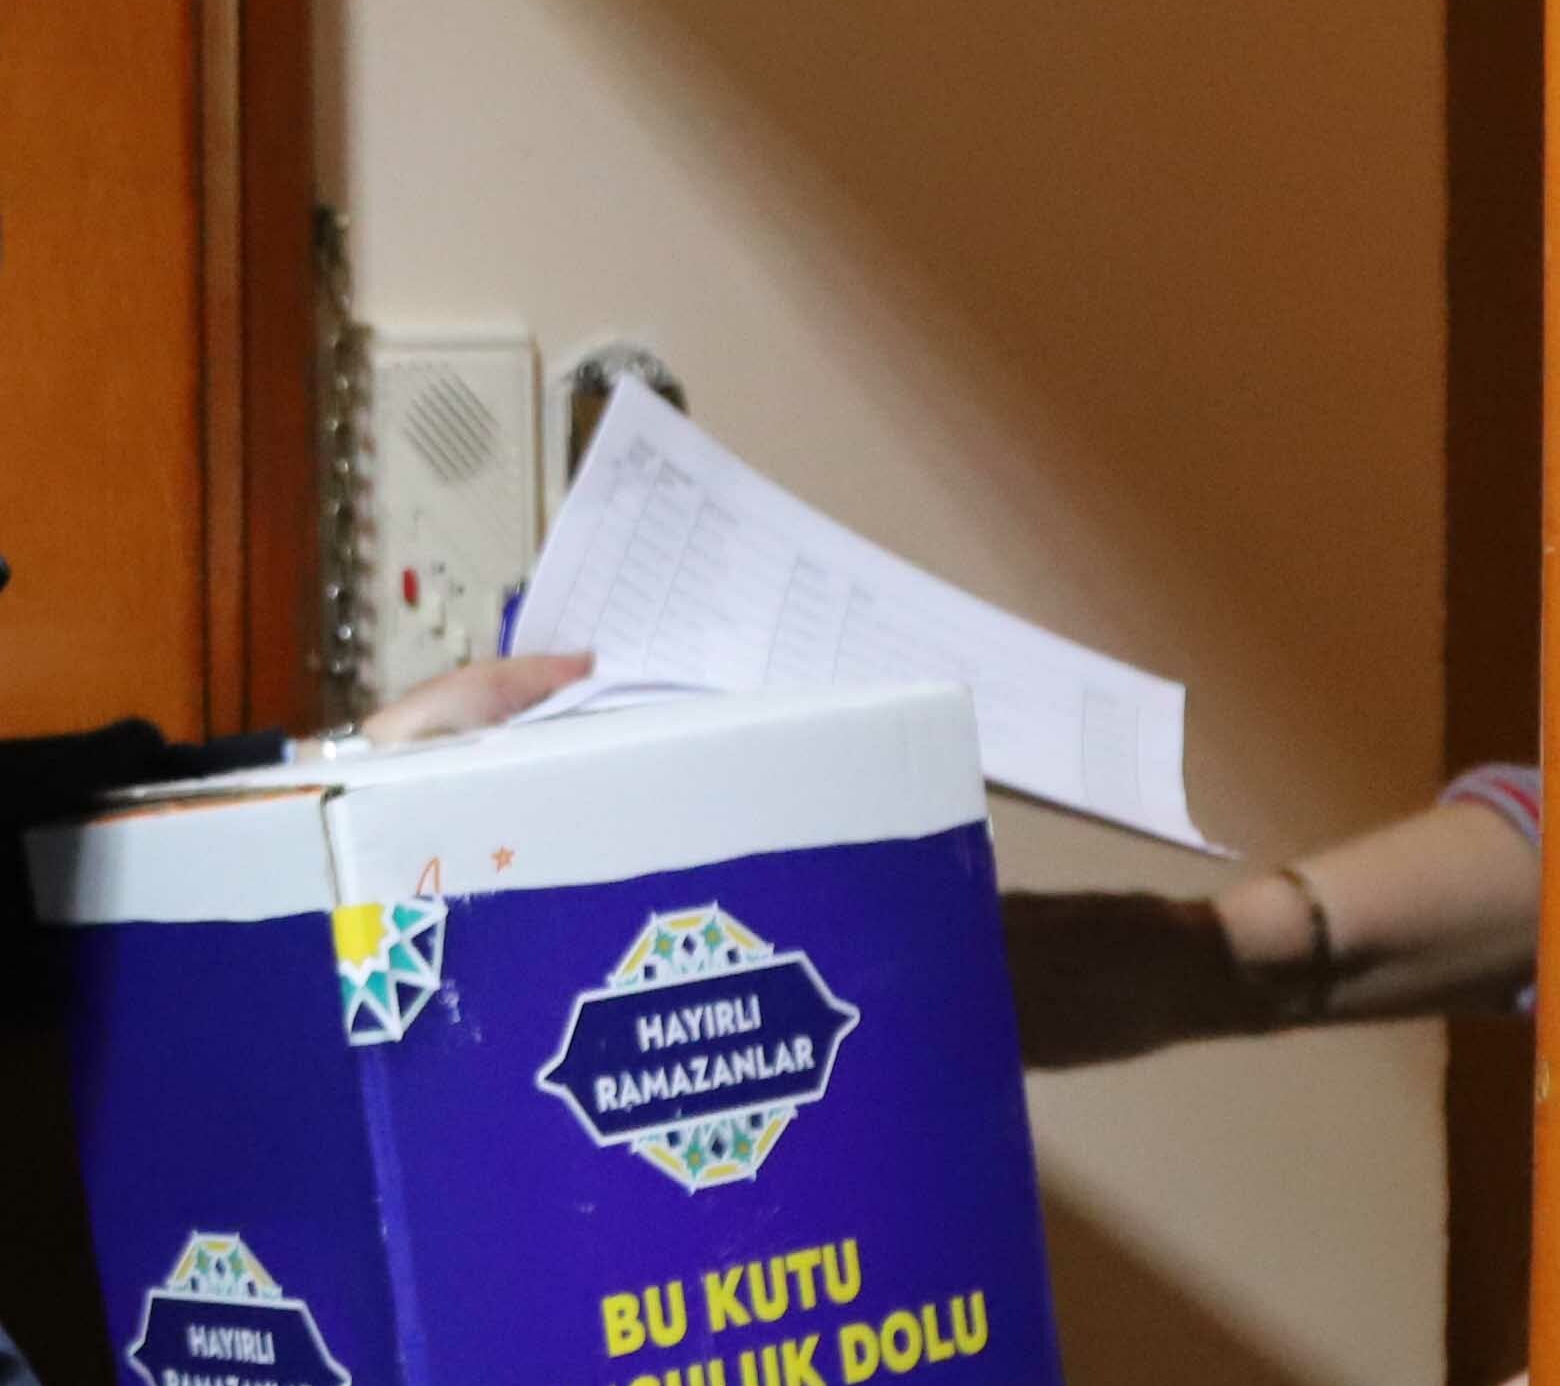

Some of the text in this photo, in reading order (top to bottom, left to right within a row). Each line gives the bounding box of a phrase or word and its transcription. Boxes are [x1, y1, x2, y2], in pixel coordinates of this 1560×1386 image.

[636, 994, 762, 1053] HAYIRLI
[593, 1034, 815, 1113] RAMAZANLAR
[601, 1238, 862, 1358] BU KUTU
[838, 1290, 989, 1385] DOLU
[187, 1322, 276, 1365] HAYIRLI
